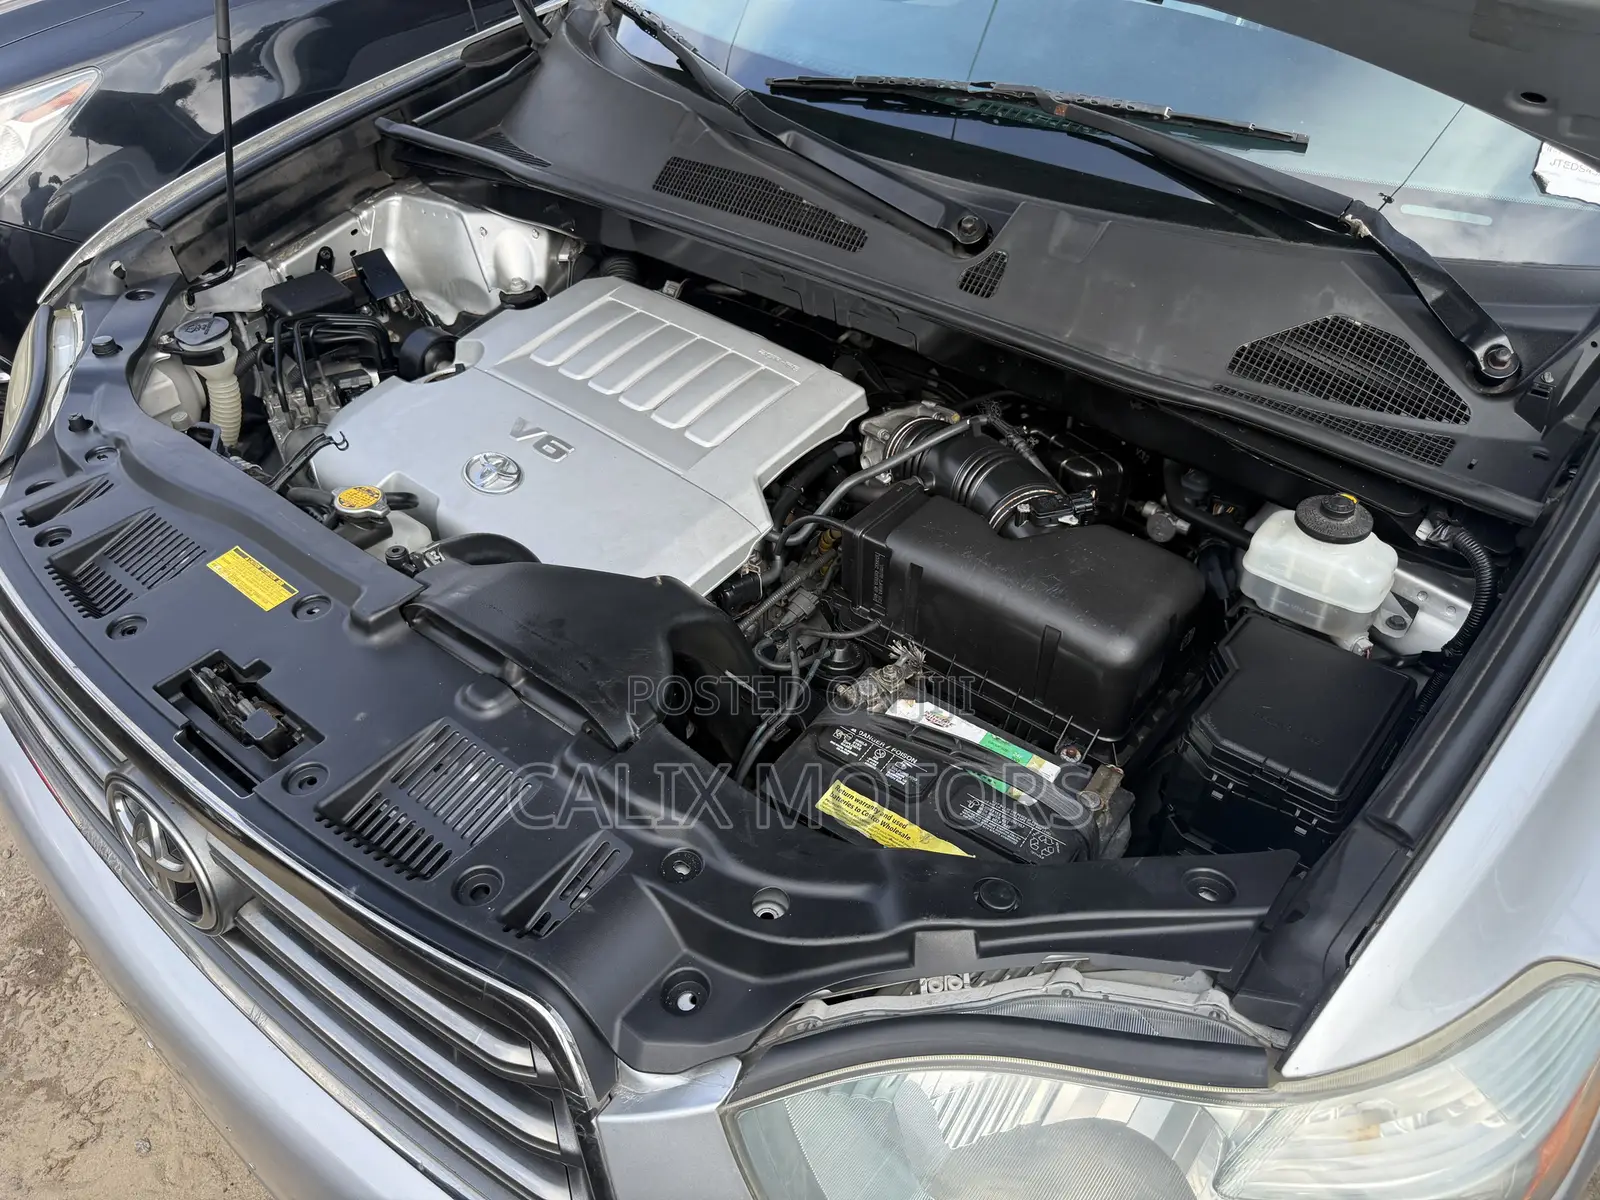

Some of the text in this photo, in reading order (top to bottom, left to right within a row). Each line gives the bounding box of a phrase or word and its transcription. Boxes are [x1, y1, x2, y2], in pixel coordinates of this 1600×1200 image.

[509, 416, 576, 463] V6
[890, 747, 918, 764] POISON
[829, 791, 855, 810] batteries
[861, 809, 880, 824] Costco
[880, 819, 912, 841] Wholesale
[834, 784, 909, 830] Return warranty and used
